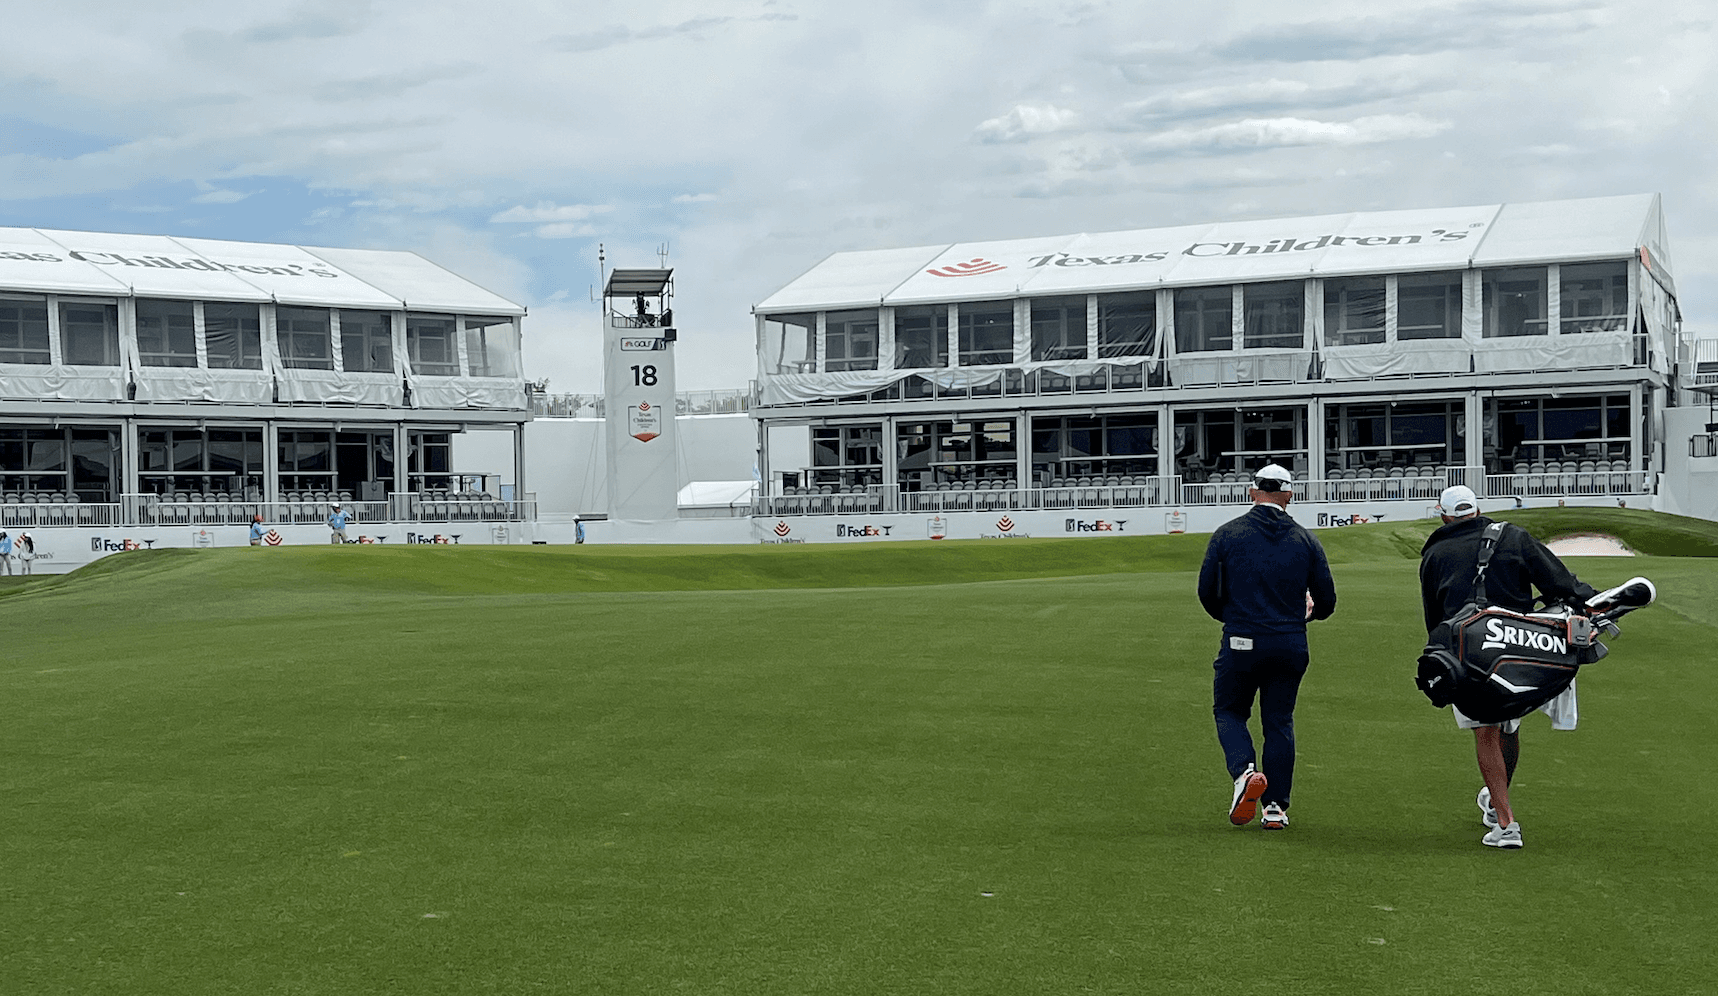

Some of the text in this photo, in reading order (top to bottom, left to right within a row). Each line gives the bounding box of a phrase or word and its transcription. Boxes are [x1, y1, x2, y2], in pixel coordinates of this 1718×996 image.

[1027, 229, 1469, 269] Texas Children's
[69, 251, 338, 278] Children's
[630, 365, 658, 386] 18
[1077, 520, 1112, 531] FedEx
[1331, 515, 1368, 526] FedEx
[847, 526, 879, 536] FedEx
[104, 539, 140, 551] FedEx
[418, 534, 449, 544] FedEx
[1484, 618, 1567, 655] SRIXON
